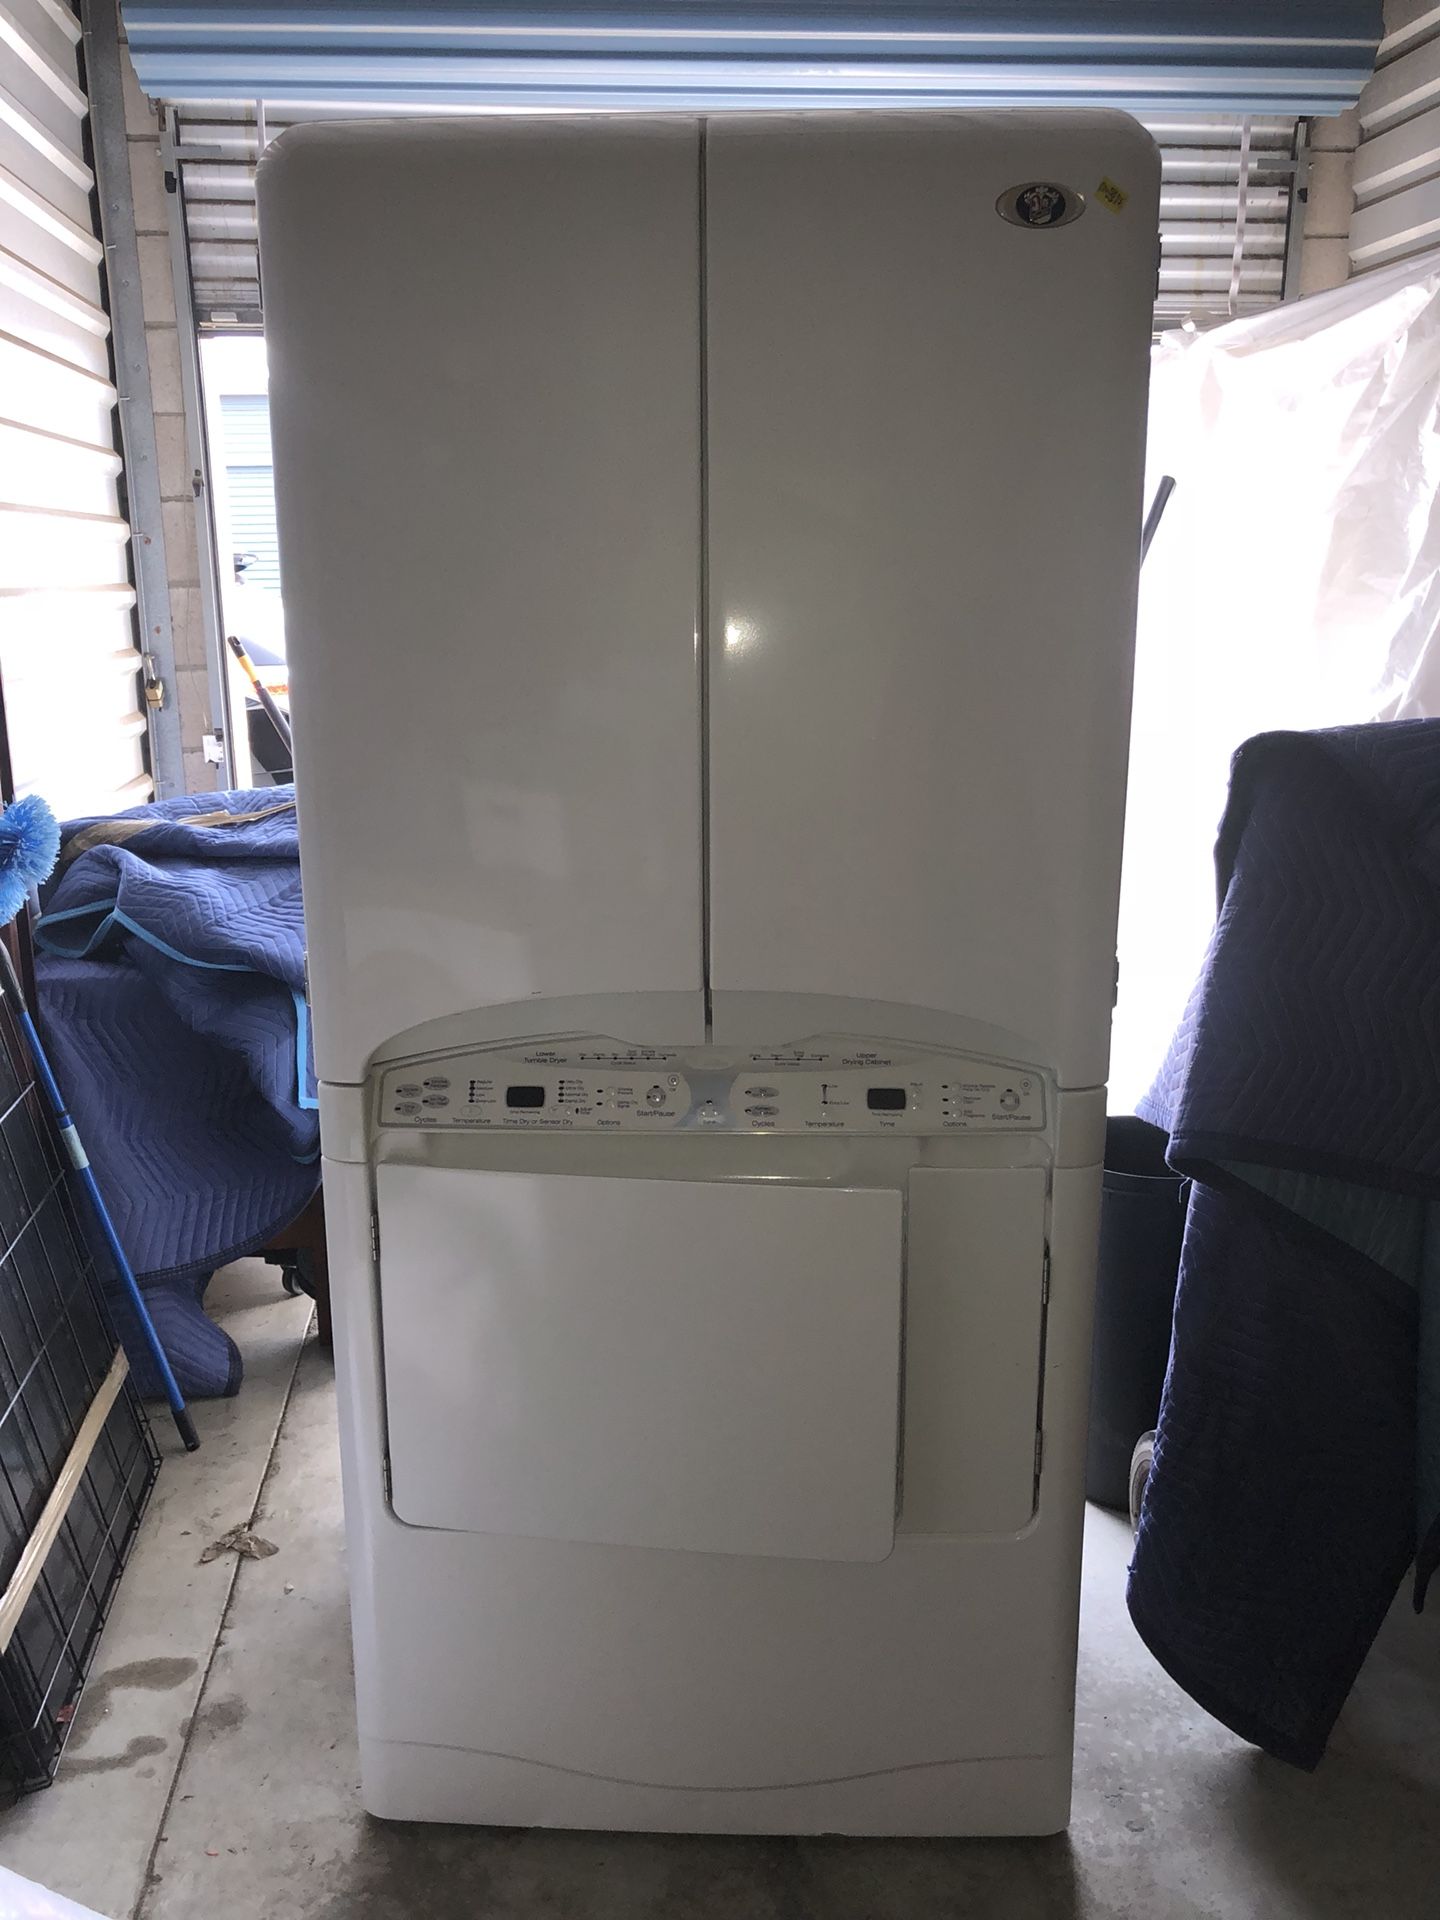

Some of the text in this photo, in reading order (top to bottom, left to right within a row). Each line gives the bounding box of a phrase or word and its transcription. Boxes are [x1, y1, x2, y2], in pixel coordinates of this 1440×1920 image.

[524, 1056, 548, 1064] Tumble
[841, 1058, 891, 1066] Drying Cabinet
[636, 1109, 676, 1118] Start/Pause
[992, 1113, 1032, 1121] Start/Pause
[414, 1116, 437, 1124] Cycles
[452, 1117, 492, 1125] Temperature
[519, 1118, 530, 1126] Dry
[752, 1120, 775, 1128] Cycles
[805, 1120, 845, 1128] Temperature
[943, 1120, 968, 1128] Options
